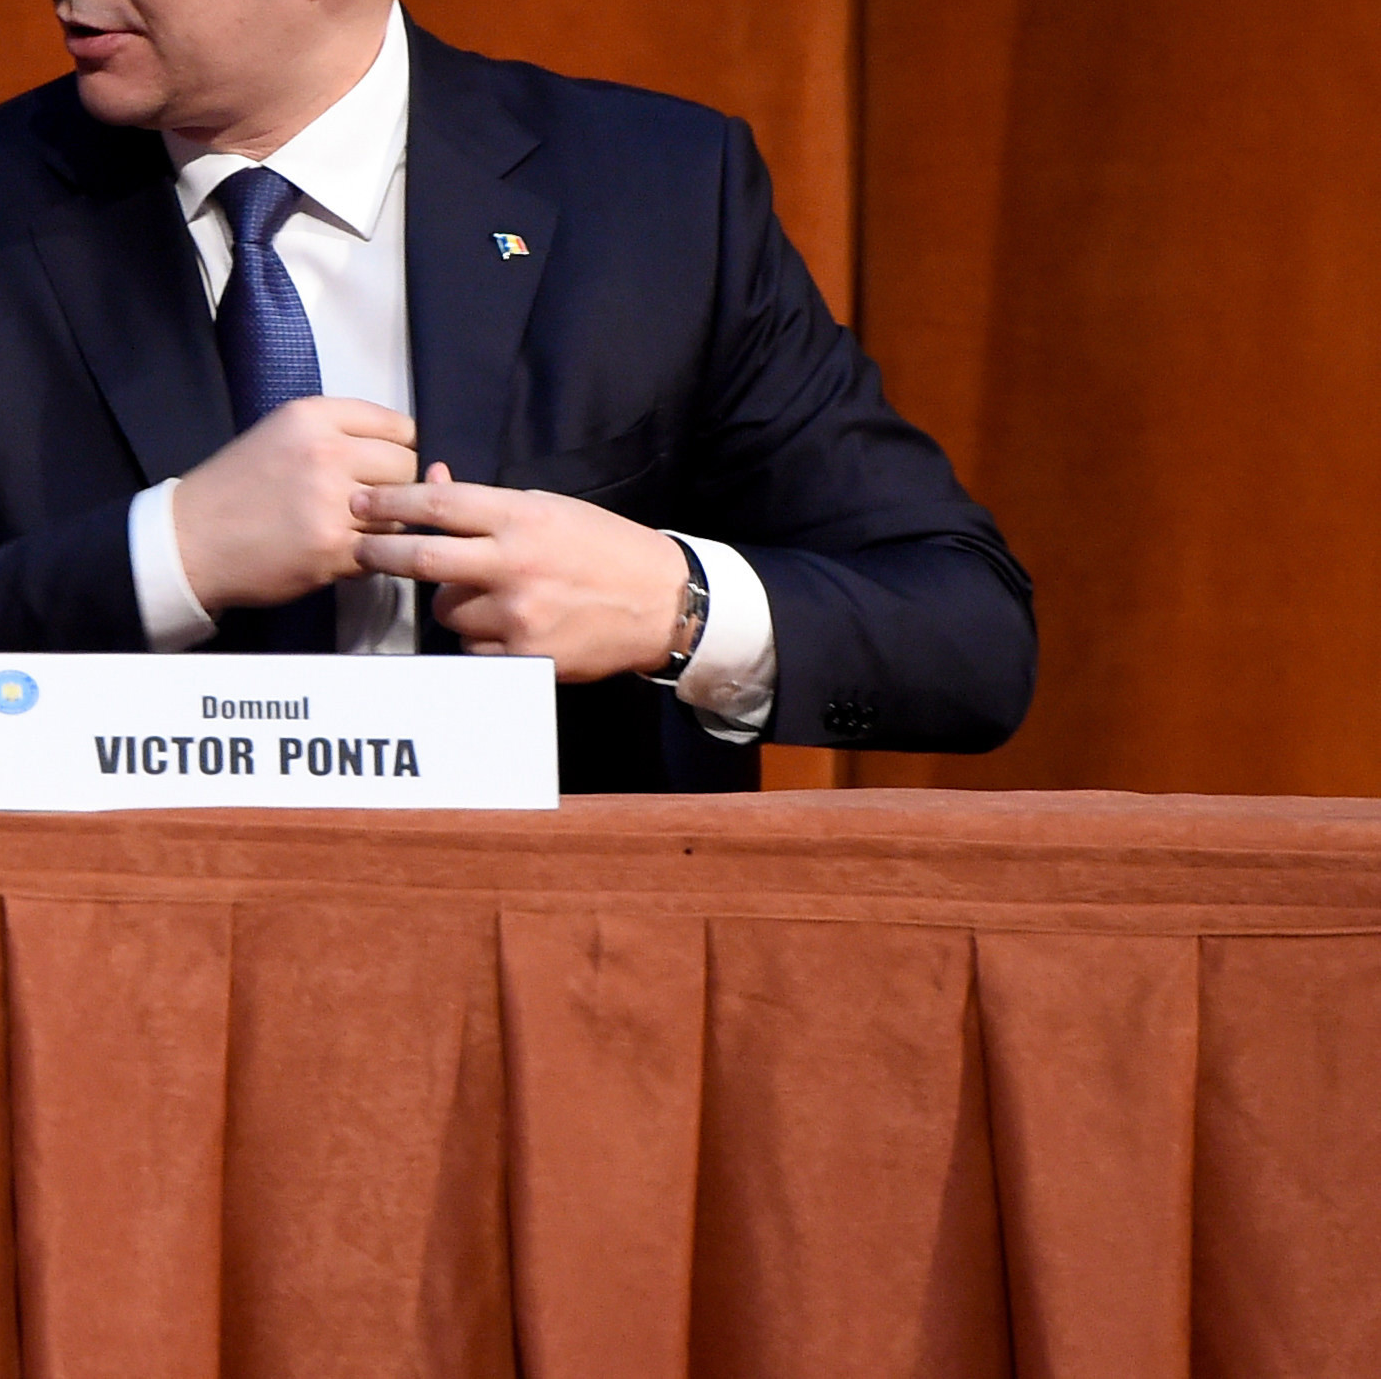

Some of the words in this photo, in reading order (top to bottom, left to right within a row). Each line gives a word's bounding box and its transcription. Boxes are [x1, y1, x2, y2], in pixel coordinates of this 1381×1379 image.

[202, 695, 309, 720] Domnul
[94, 735, 254, 776] VICTOR
[279, 737, 420, 777] PONTA
